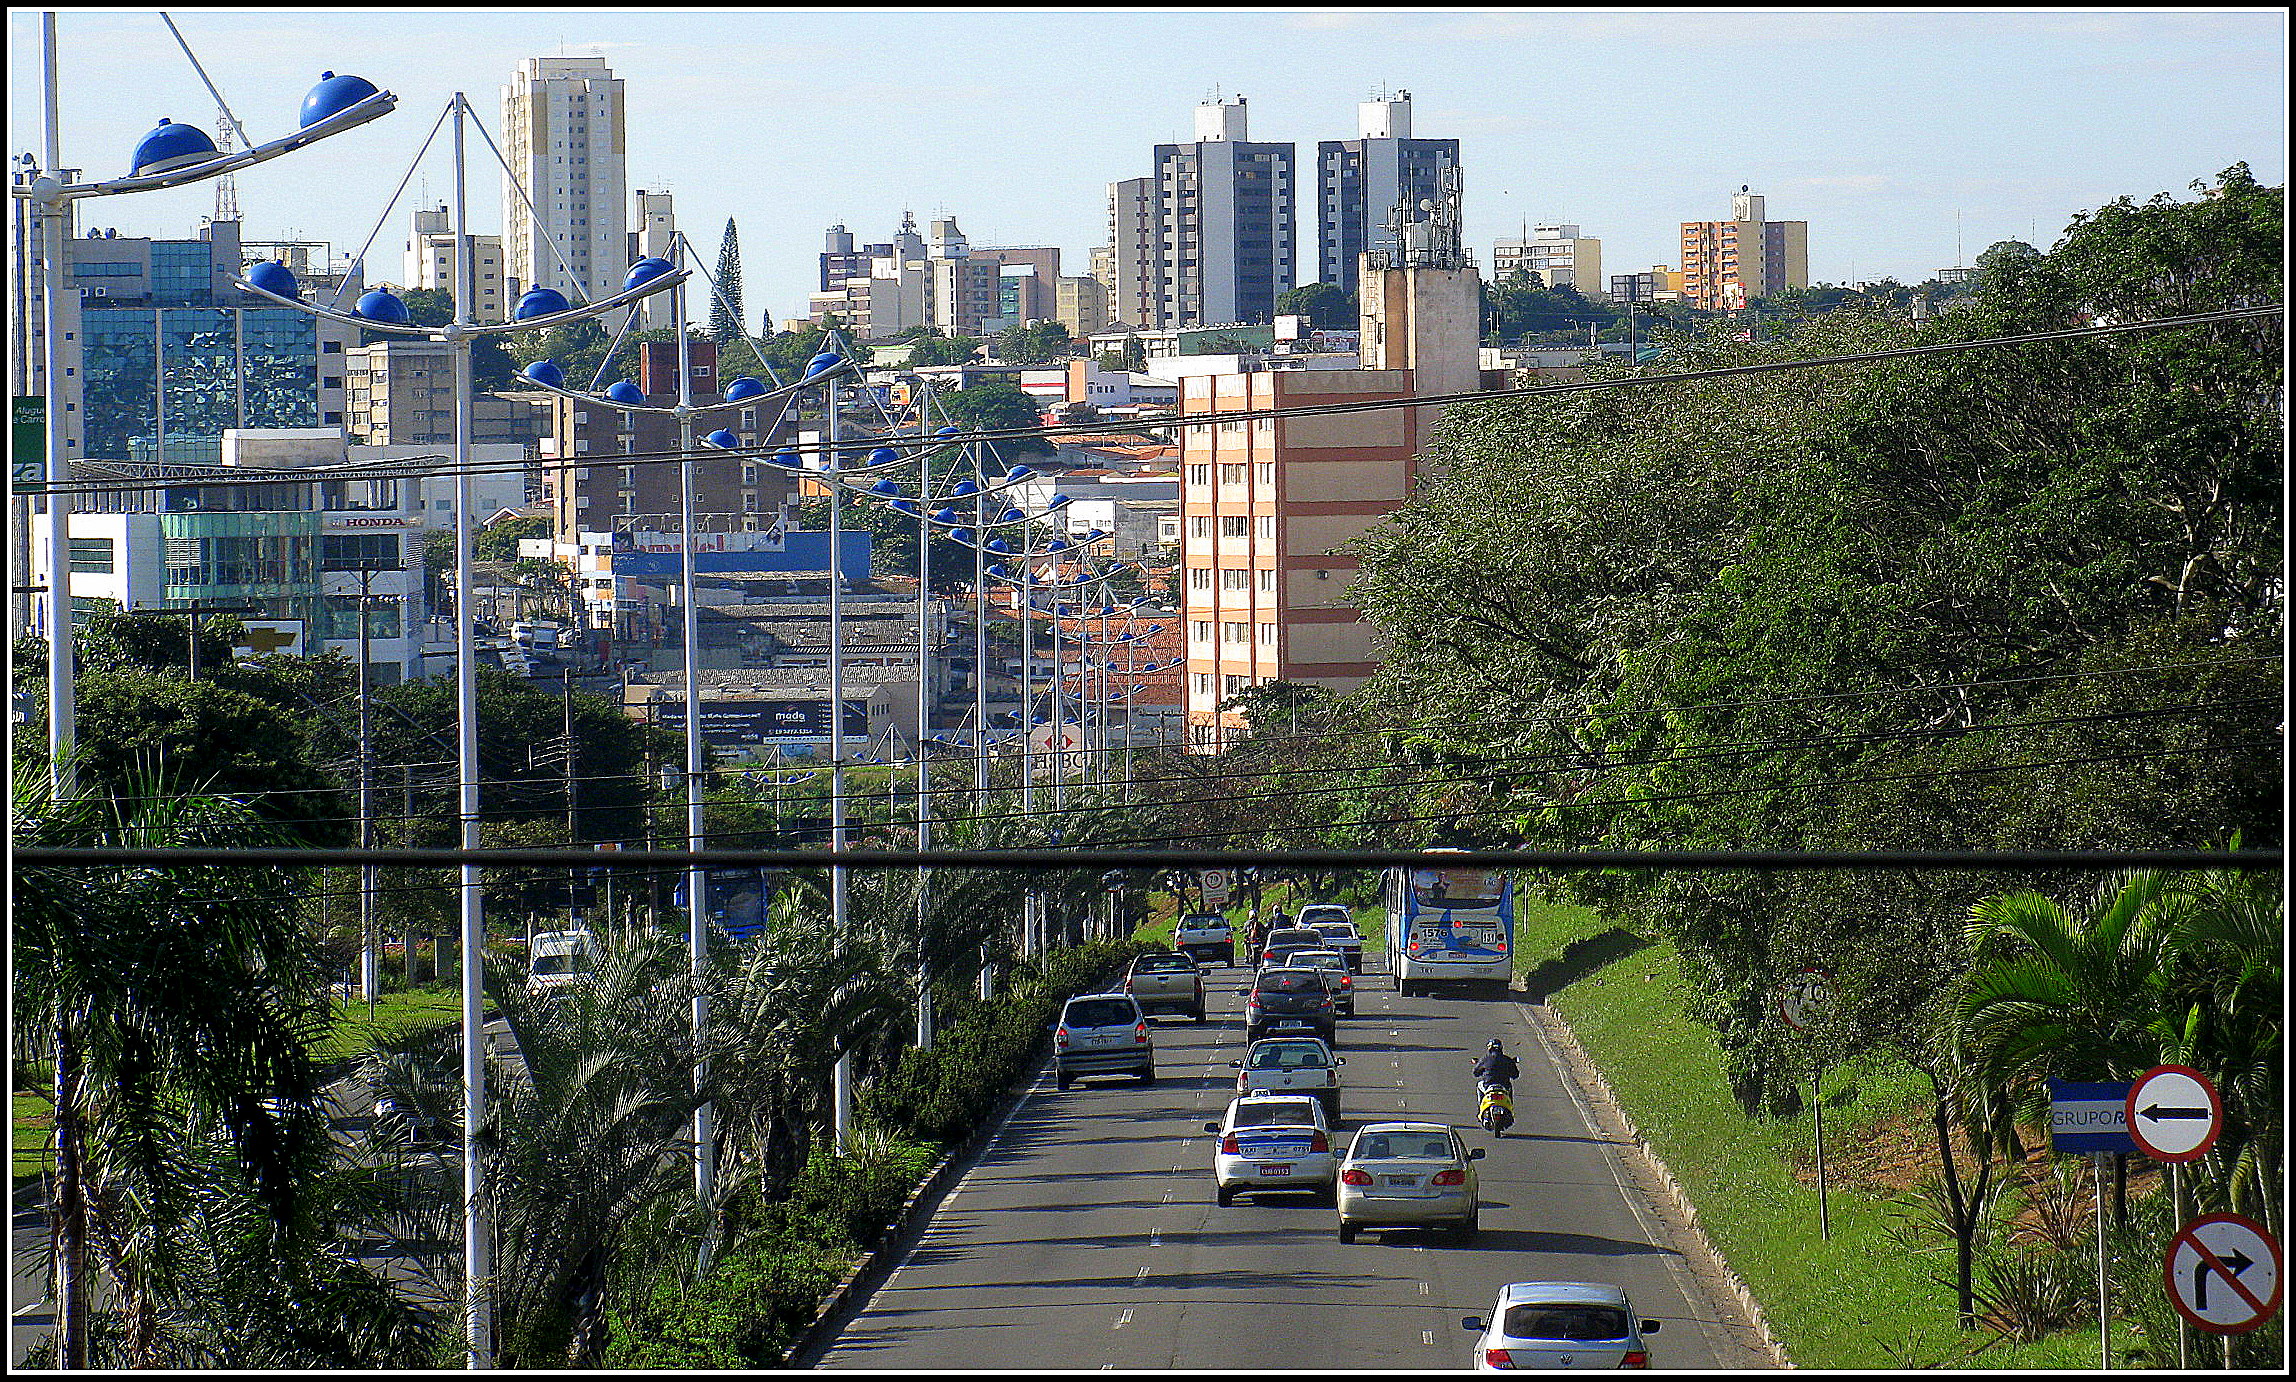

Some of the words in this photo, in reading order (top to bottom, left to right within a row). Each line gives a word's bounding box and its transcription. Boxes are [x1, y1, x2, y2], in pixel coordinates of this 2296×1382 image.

[346, 518, 406, 527] HONDA
[1033, 752, 1084, 769] HBC
[1422, 929, 1448, 938] 1576
